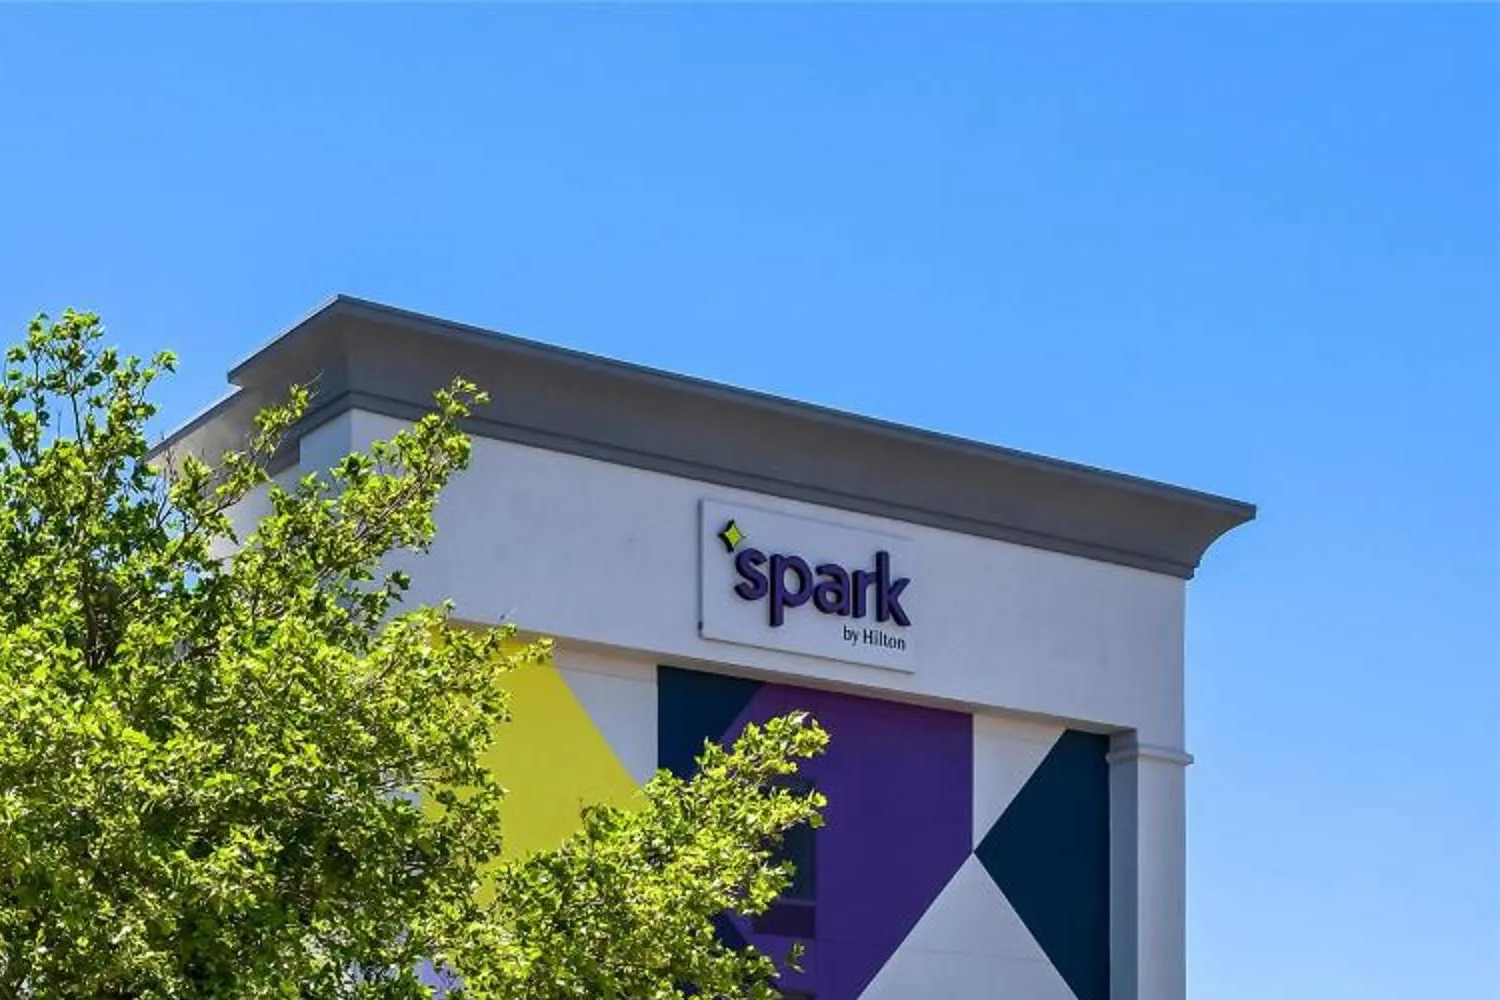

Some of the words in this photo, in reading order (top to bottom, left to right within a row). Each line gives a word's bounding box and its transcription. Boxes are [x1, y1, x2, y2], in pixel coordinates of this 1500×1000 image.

[733, 548, 912, 627] spark
[843, 625, 860, 646] by
[863, 628, 906, 651] Hilton
